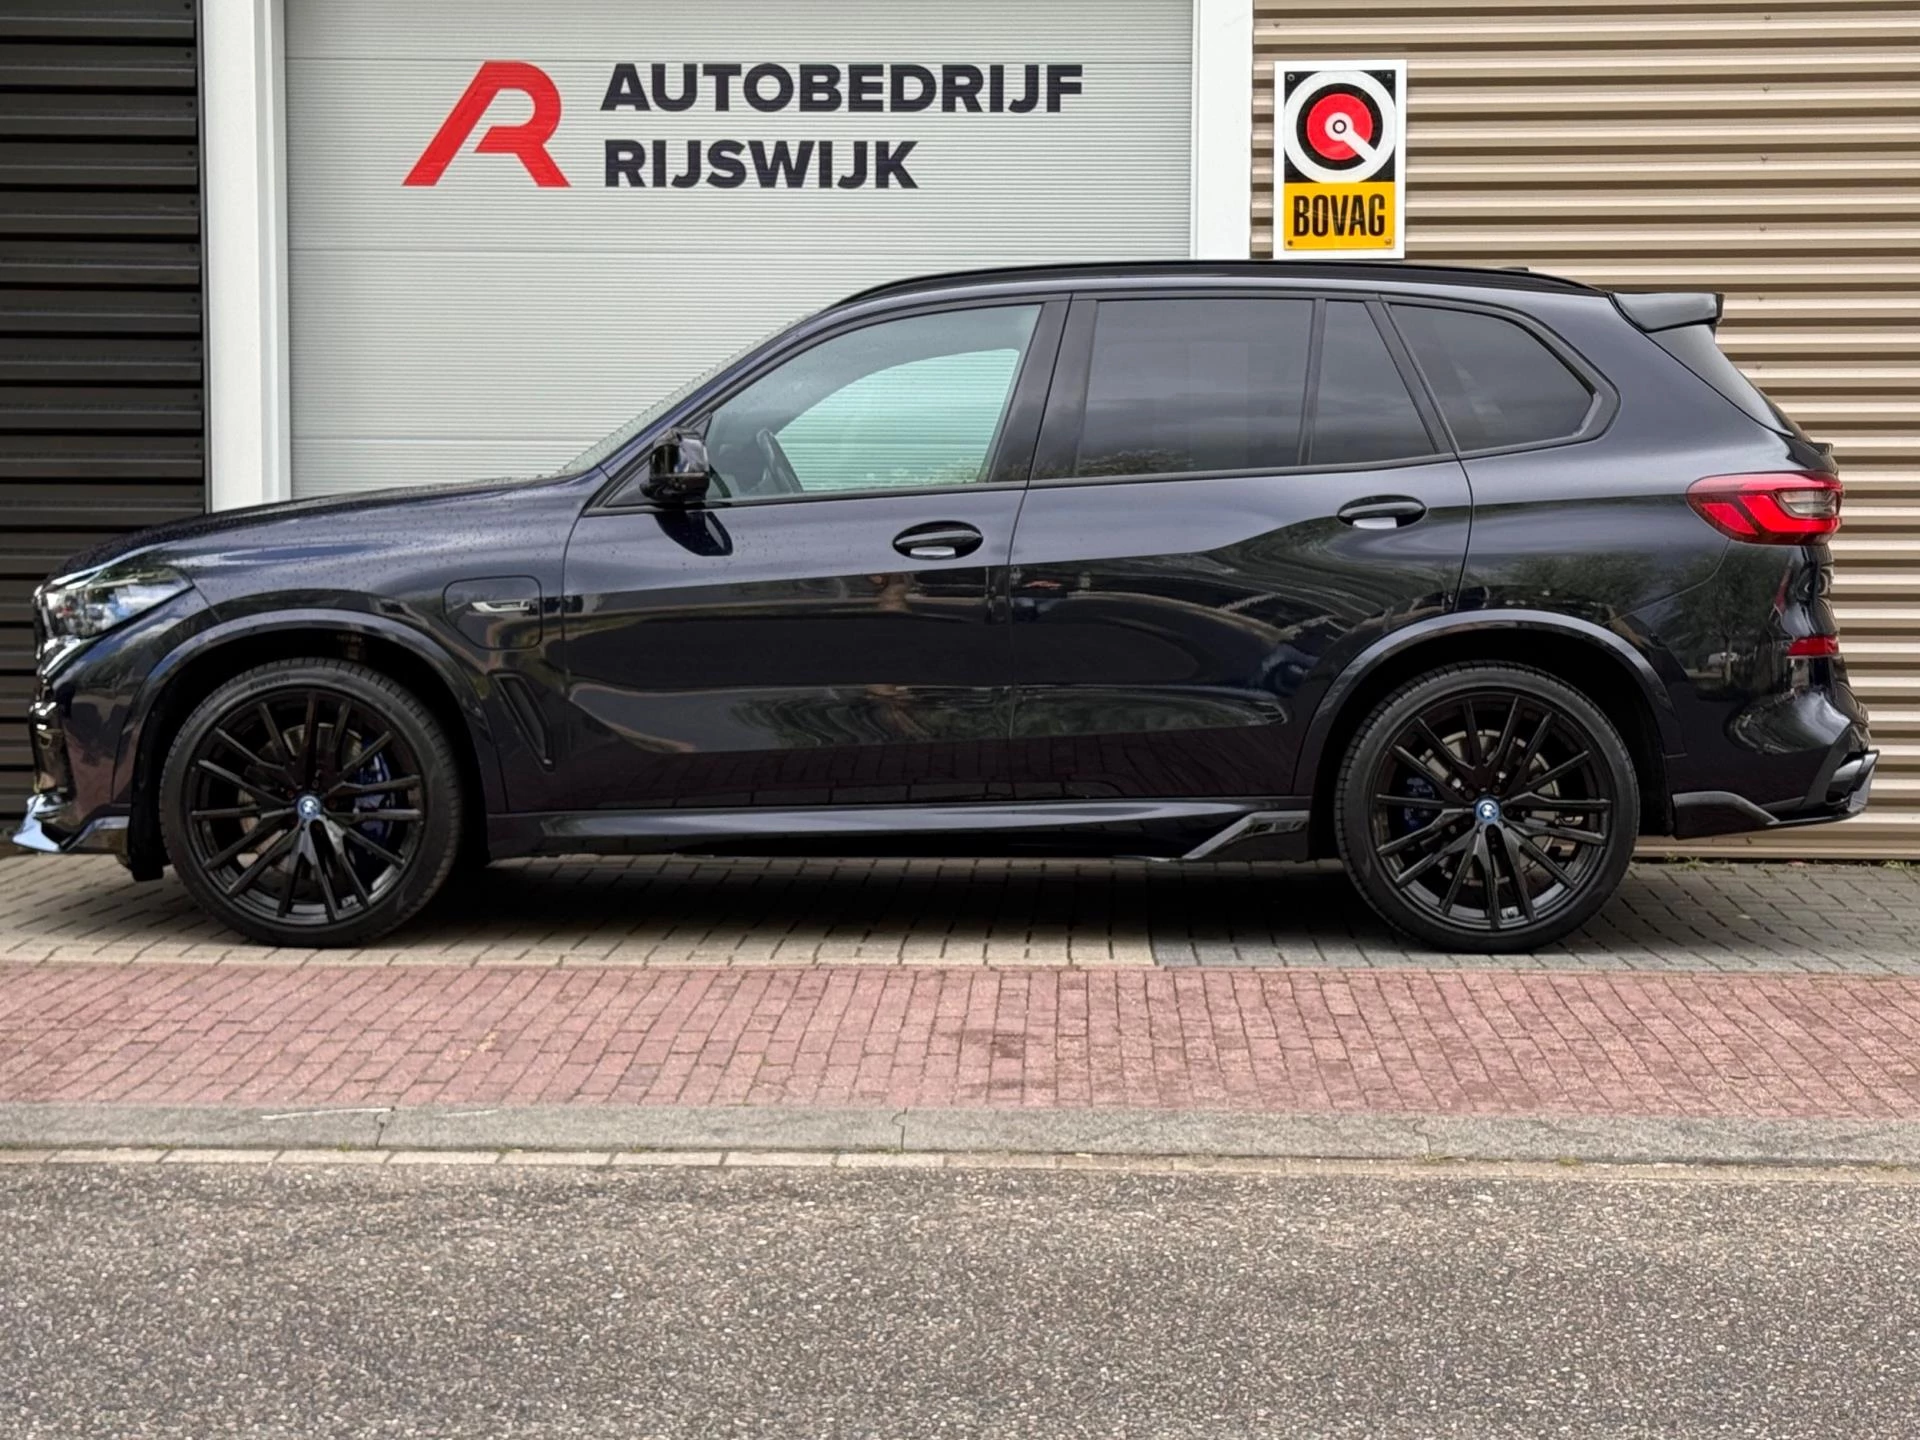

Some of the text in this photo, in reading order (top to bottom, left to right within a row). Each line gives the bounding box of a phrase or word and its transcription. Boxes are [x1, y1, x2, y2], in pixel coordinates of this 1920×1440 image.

[600, 62, 1083, 114] AUTOBEDRIJF
[605, 139, 918, 190] RIJSWIJK
[1293, 193, 1386, 237] BOVAG
